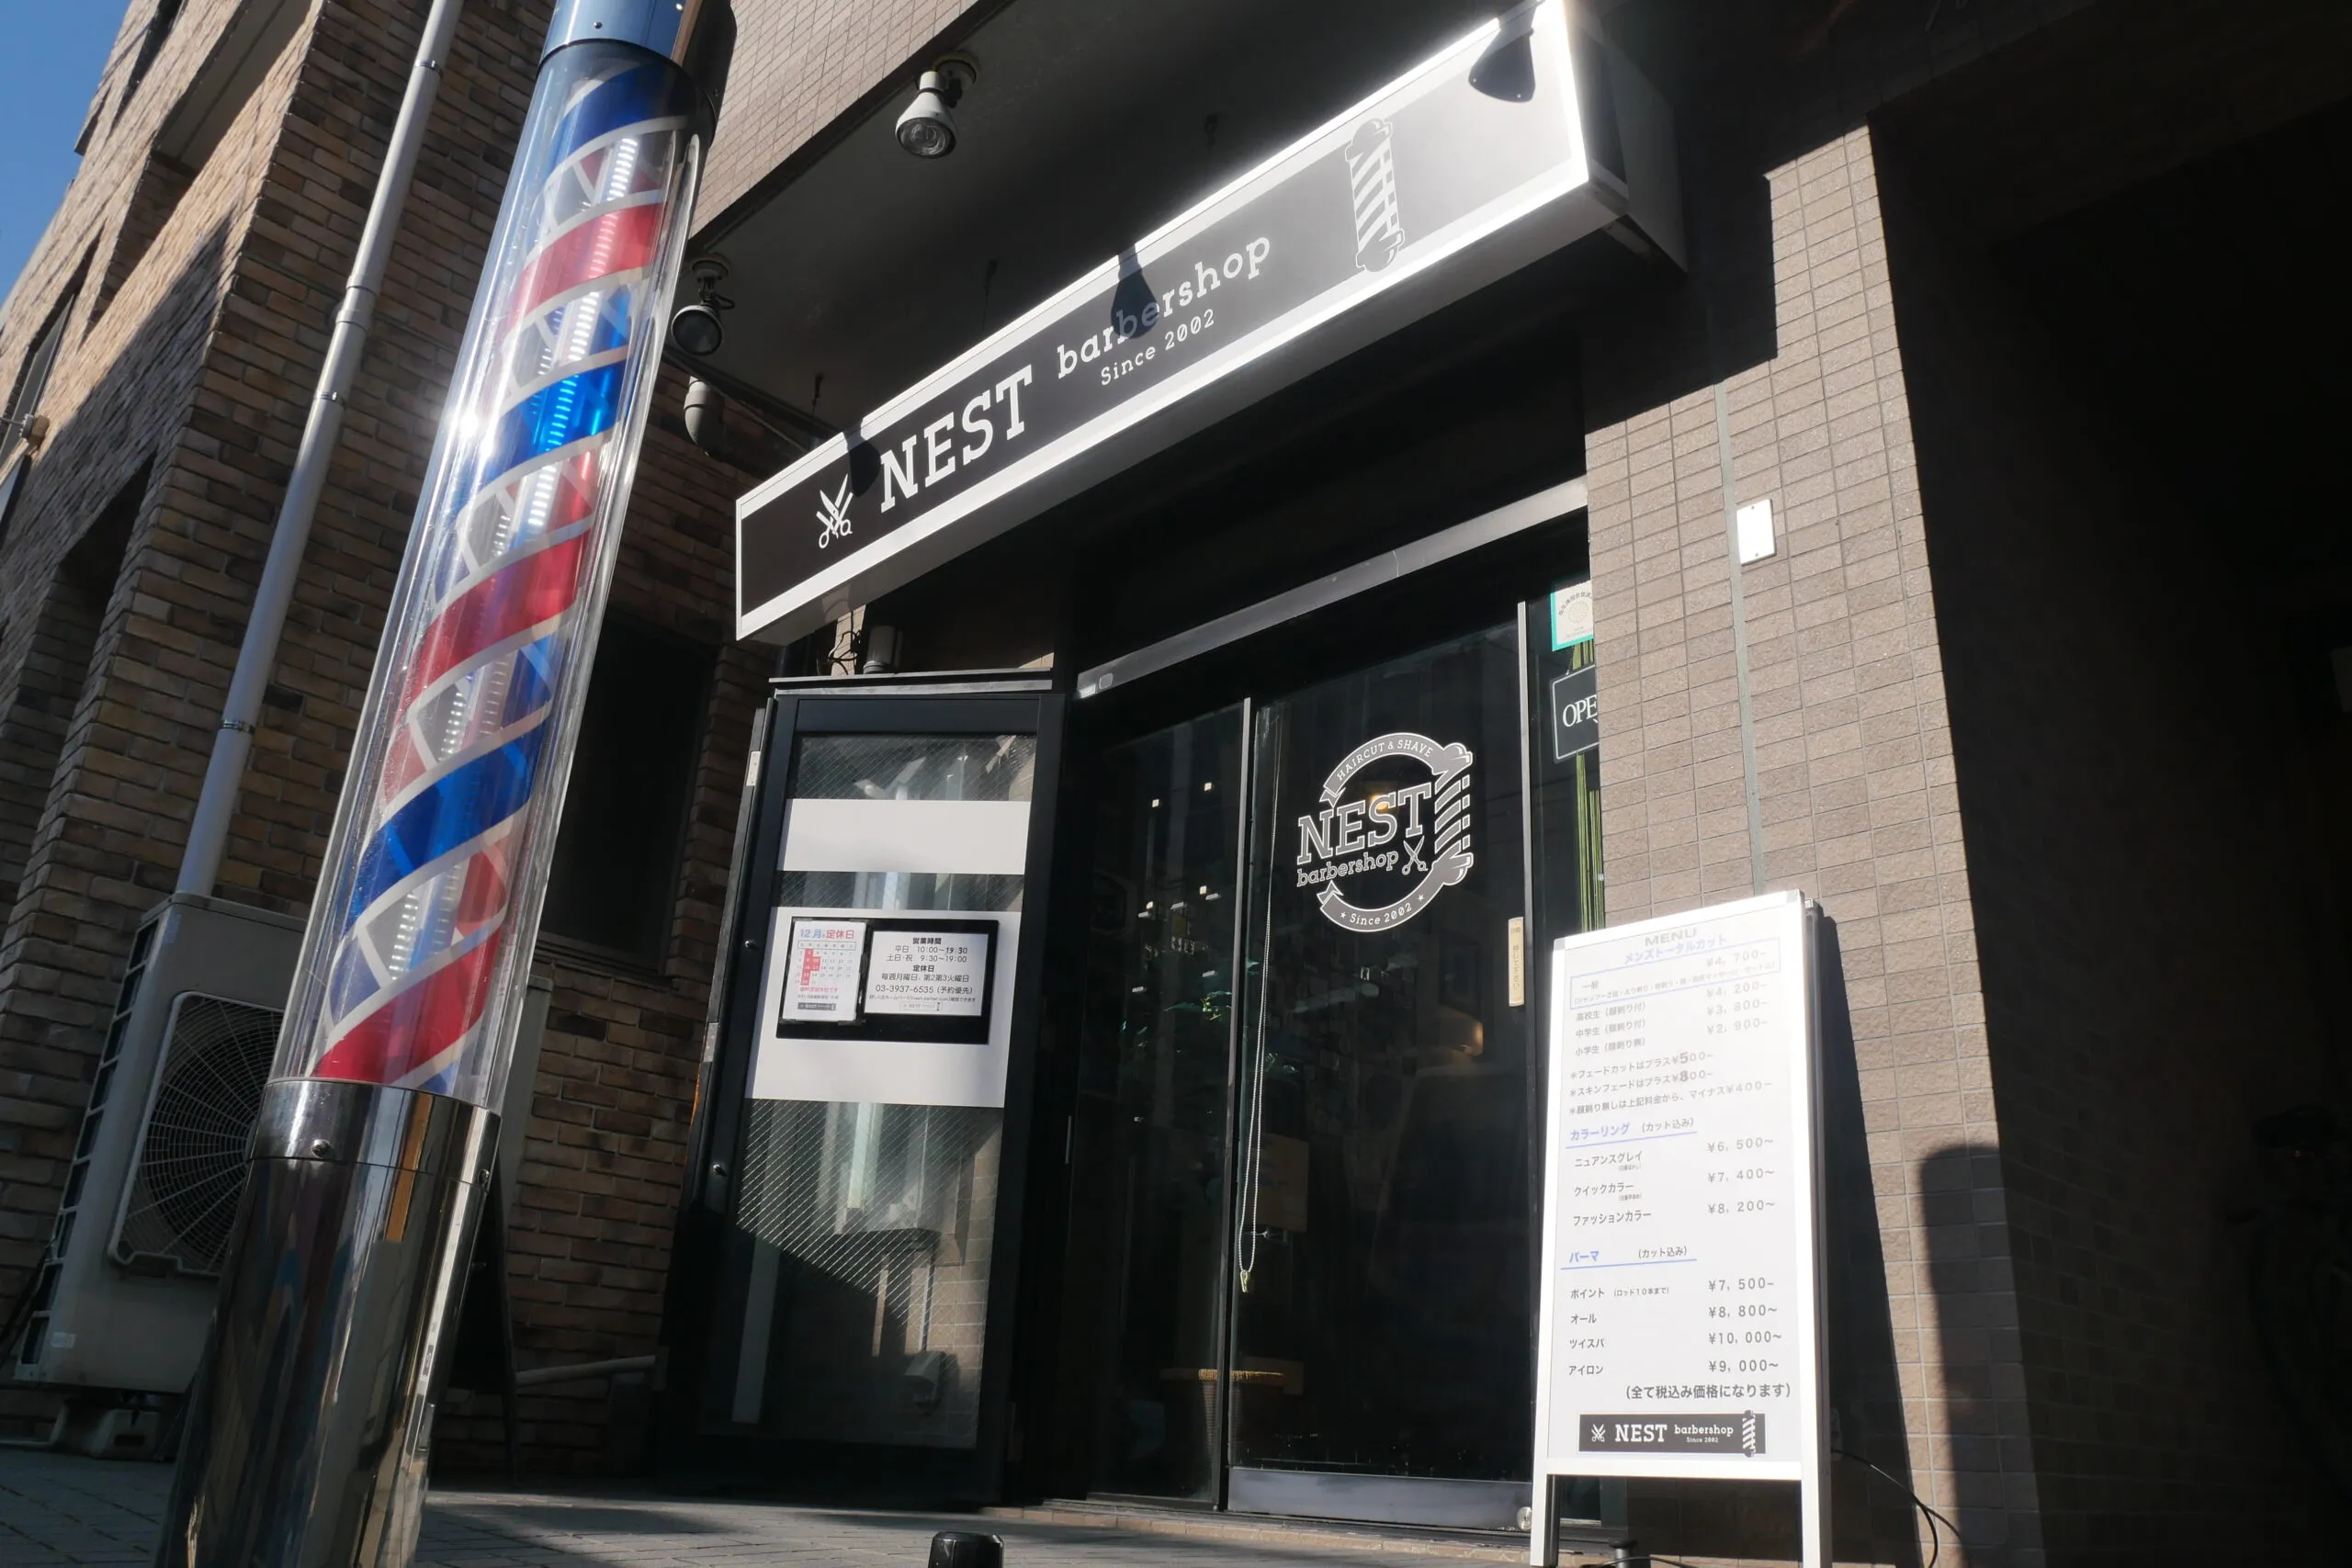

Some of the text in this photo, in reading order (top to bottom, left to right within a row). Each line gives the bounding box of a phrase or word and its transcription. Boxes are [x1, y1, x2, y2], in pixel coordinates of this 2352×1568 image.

[1057, 236, 1271, 379] barbershop
[1101, 309, 1215, 386] Since 2002
[880, 365, 1032, 513] NEST
[1336, 739, 1433, 782] HAIRCUT & SHAVE
[1296, 781, 1432, 865] NEST
[1296, 851, 1399, 887] barbershop
[1350, 902, 1412, 926] Since 2002
[1645, 928, 1698, 947] MENU
[895, 945, 910, 953] 平日
[1624, 933, 1726, 964] メンズトータルカット
[1570, 1122, 1631, 1141] カラーリング
[1575, 1150, 1643, 1168] ニュアンスグレイ
[1574, 1182, 1634, 1197] クイックカラー
[1573, 1210, 1652, 1226] ファッションカラー
[1569, 1246, 1687, 1263] パーマ (カット込み)
[1570, 1288, 1605, 1299] ポイント
[1570, 1313, 1597, 1325] オール
[1569, 1338, 1605, 1349] ツイスパ
[1568, 1364, 1604, 1376] アイロン
[1626, 1382, 1791, 1399] (全て税込み価格になります)
[1614, 1424, 1734, 1443] NEST barbershop
